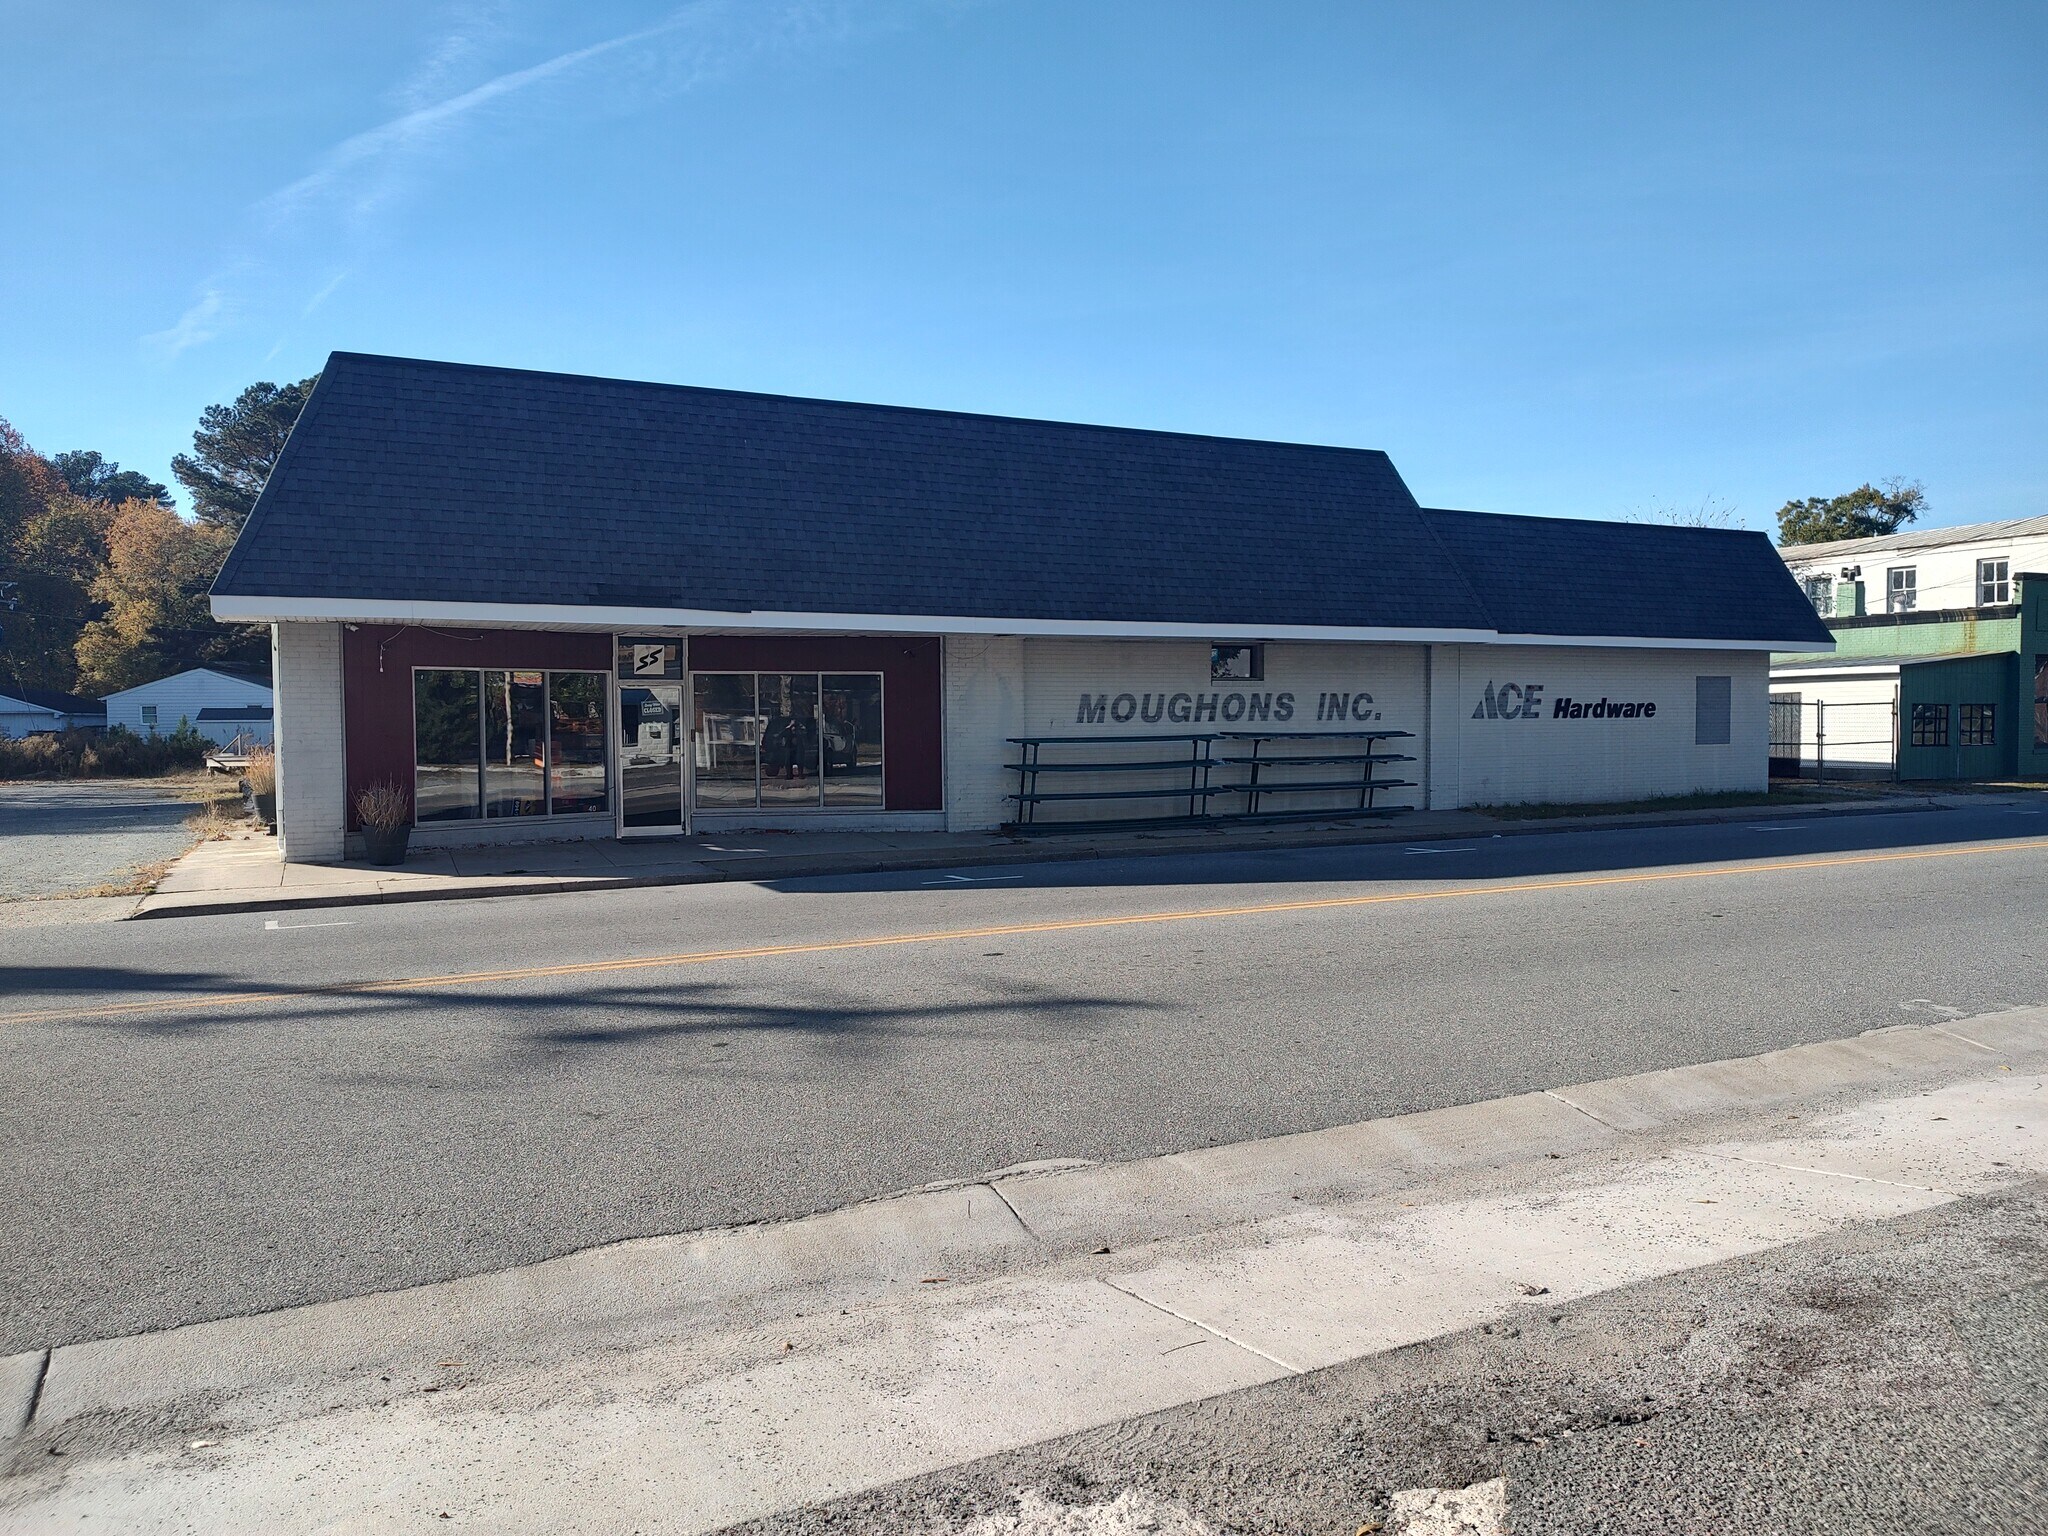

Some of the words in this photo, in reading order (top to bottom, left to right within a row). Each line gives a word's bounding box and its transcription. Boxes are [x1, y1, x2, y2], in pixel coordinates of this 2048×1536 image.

[1076, 692, 1296, 724] MOUGHONS
[1316, 692, 1382, 722] INC.
[1471, 680, 1545, 720] ACE
[1553, 697, 1657, 719] Hardware
